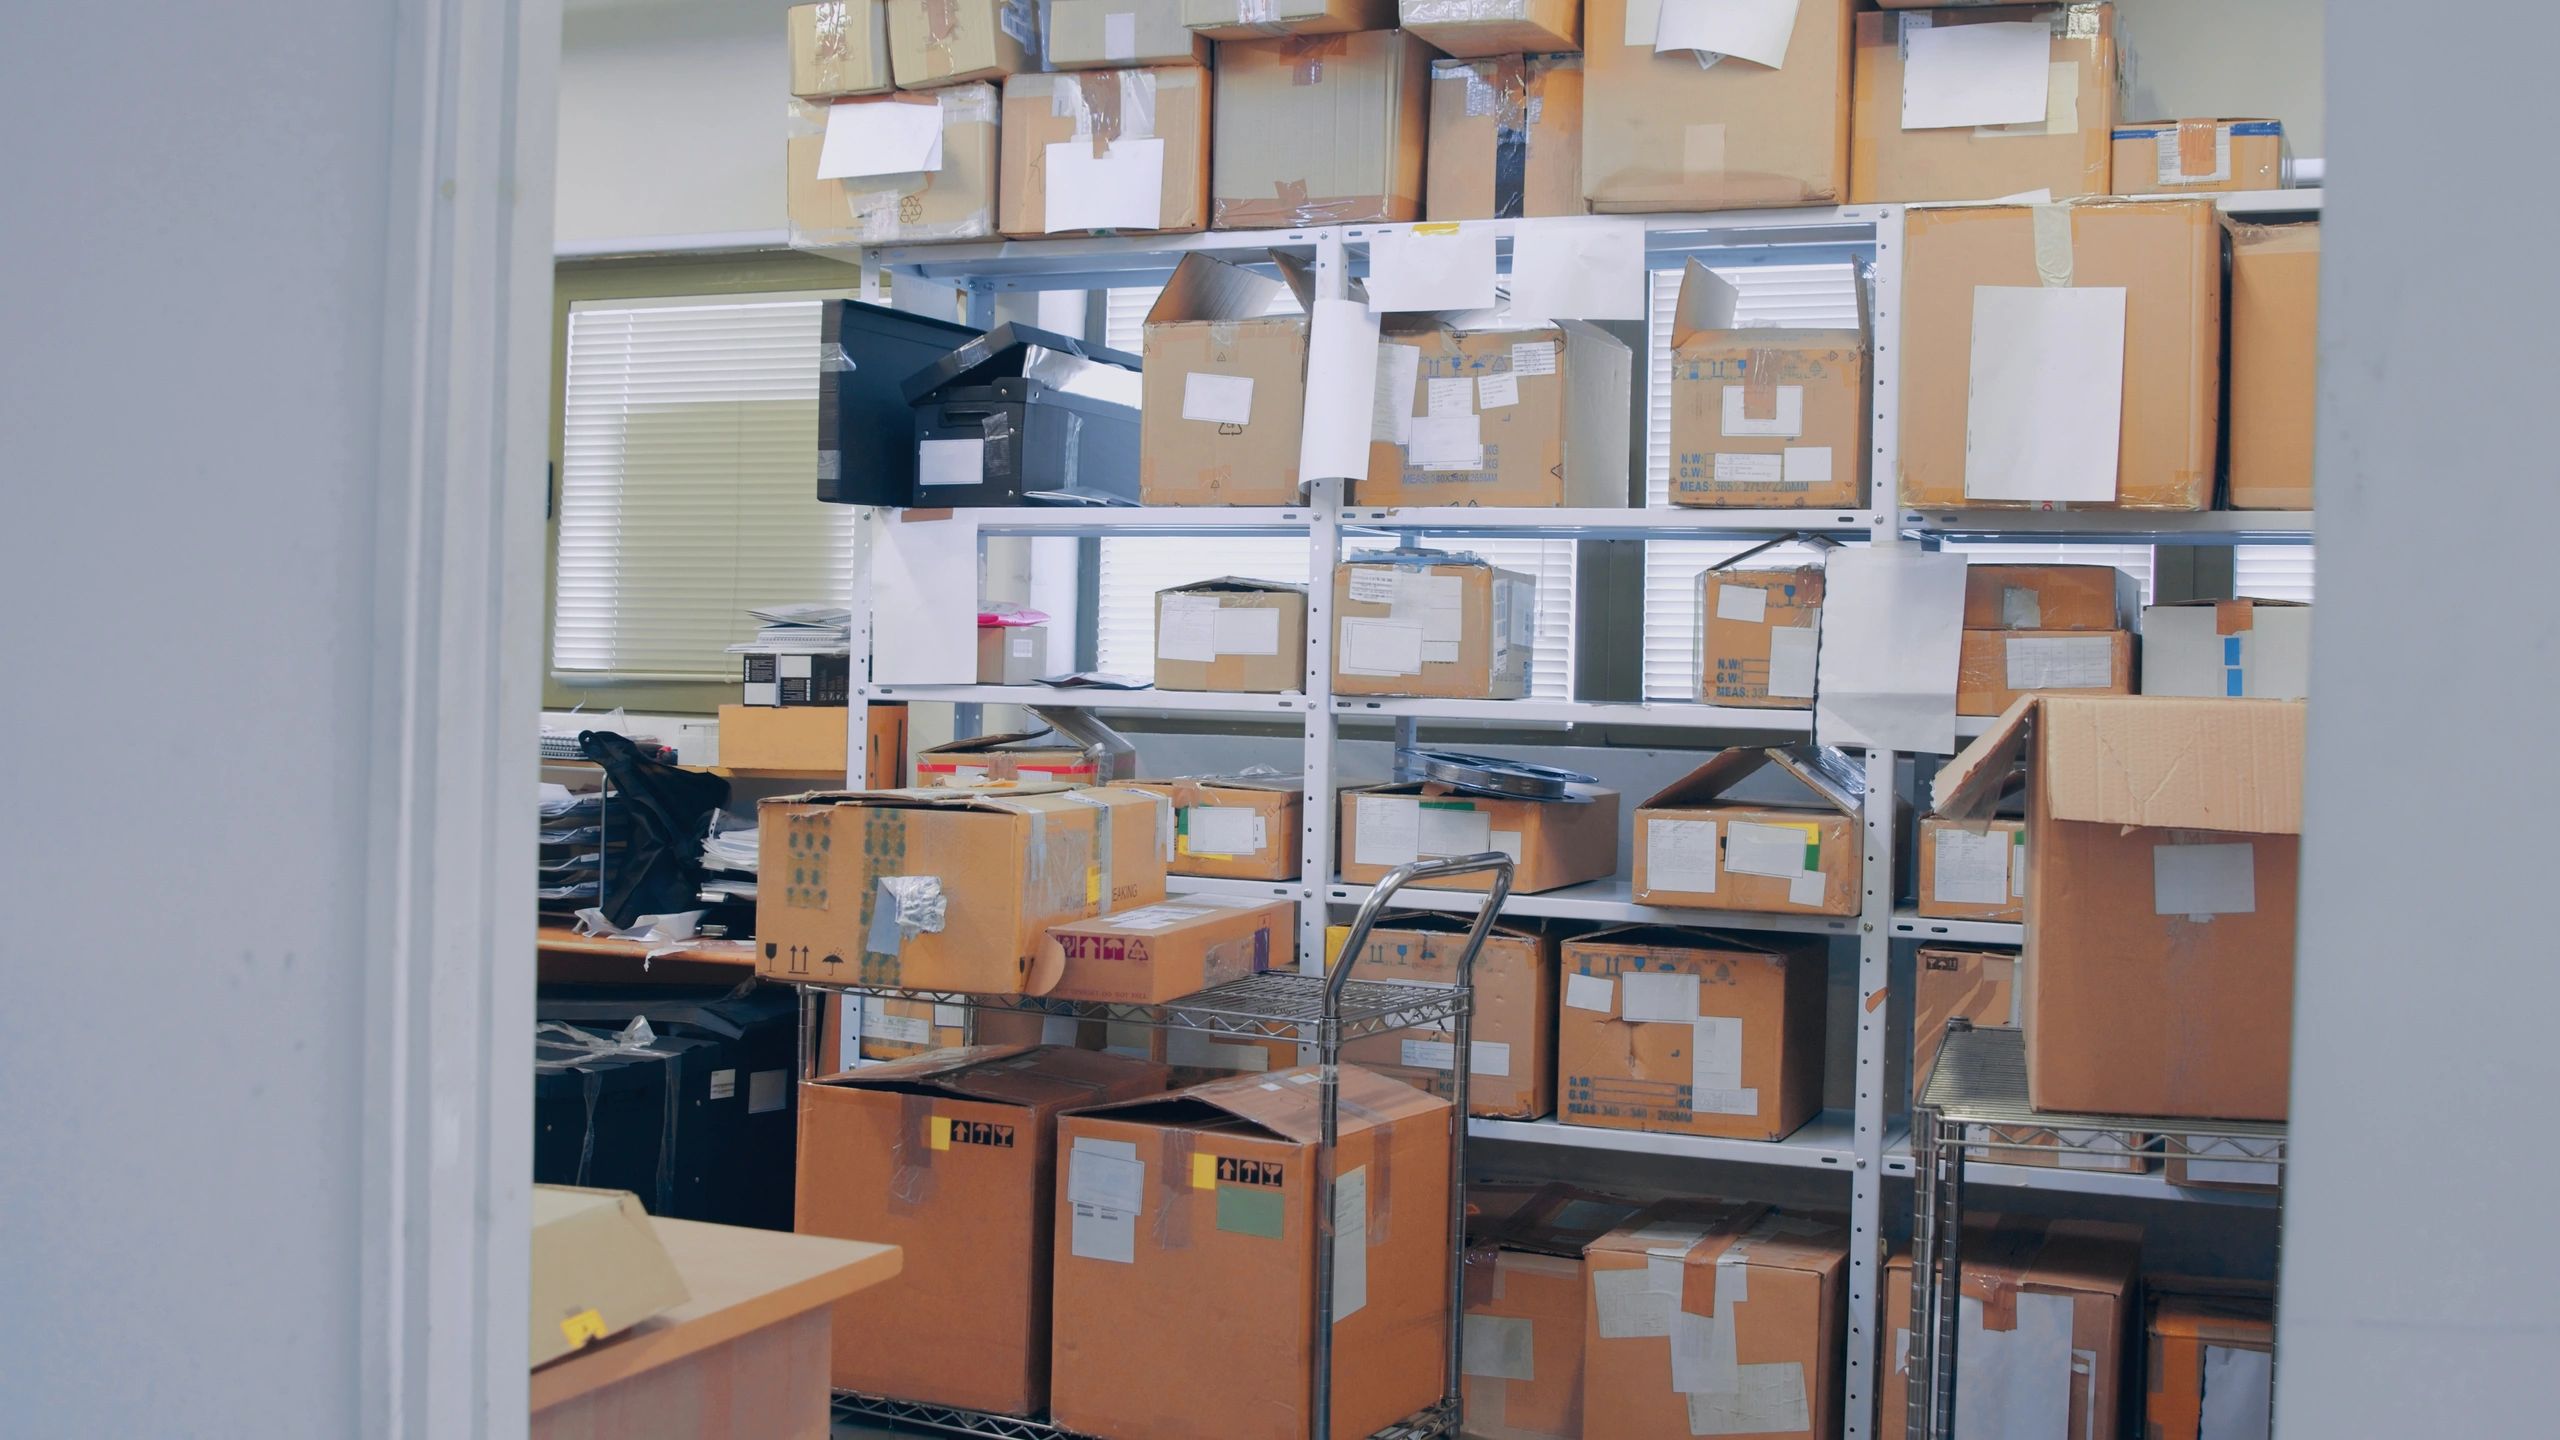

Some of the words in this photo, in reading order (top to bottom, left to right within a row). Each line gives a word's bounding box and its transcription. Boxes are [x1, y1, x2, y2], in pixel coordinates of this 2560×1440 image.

[1681, 453, 1704, 465] N.W:
[1680, 481, 1712, 492] MEAS:
[1718, 657, 1740, 670] N.W:
[1716, 686, 1749, 698] MEAS:
